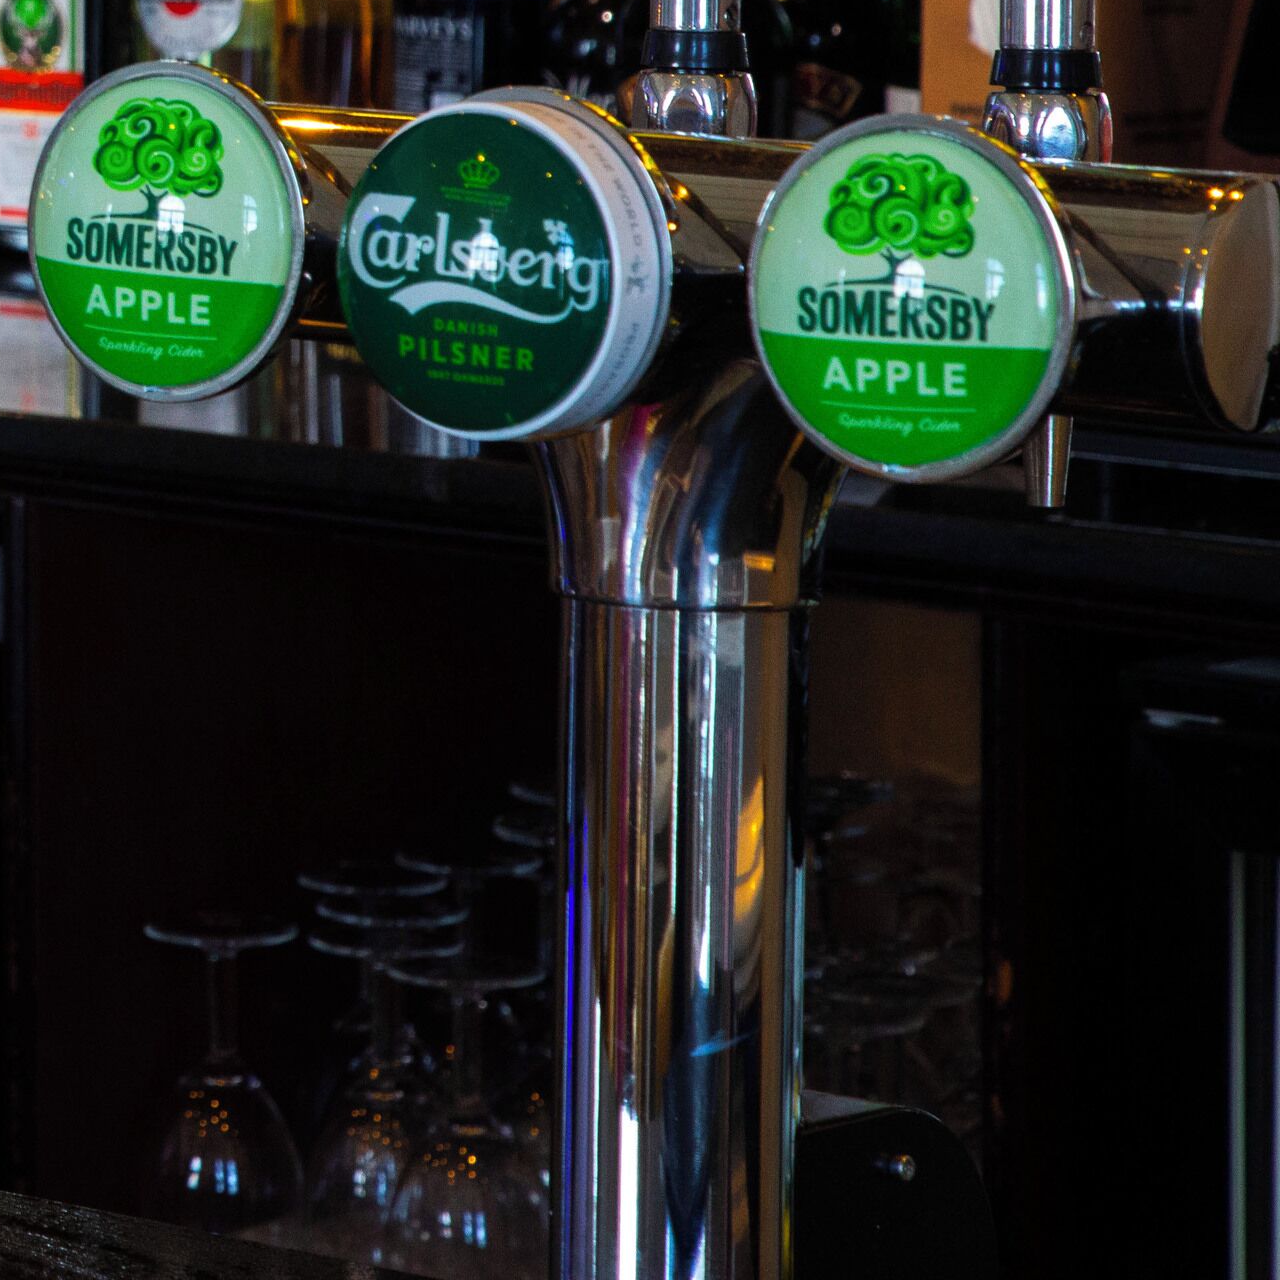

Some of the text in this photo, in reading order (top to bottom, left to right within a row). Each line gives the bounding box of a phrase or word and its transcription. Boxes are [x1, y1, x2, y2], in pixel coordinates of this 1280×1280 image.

[66, 217, 239, 277] SOMERSBY
[347, 191, 609, 320] Carlsberg
[85, 282, 212, 327] APPLE
[796, 285, 996, 343] SOMERSBY
[97, 335, 206, 361] Sparkling Cider
[432, 318, 500, 338] DANISH
[397, 333, 536, 372] PILSNER
[822, 355, 969, 398] APPLE
[837, 412, 963, 438] Sparkling Cider
